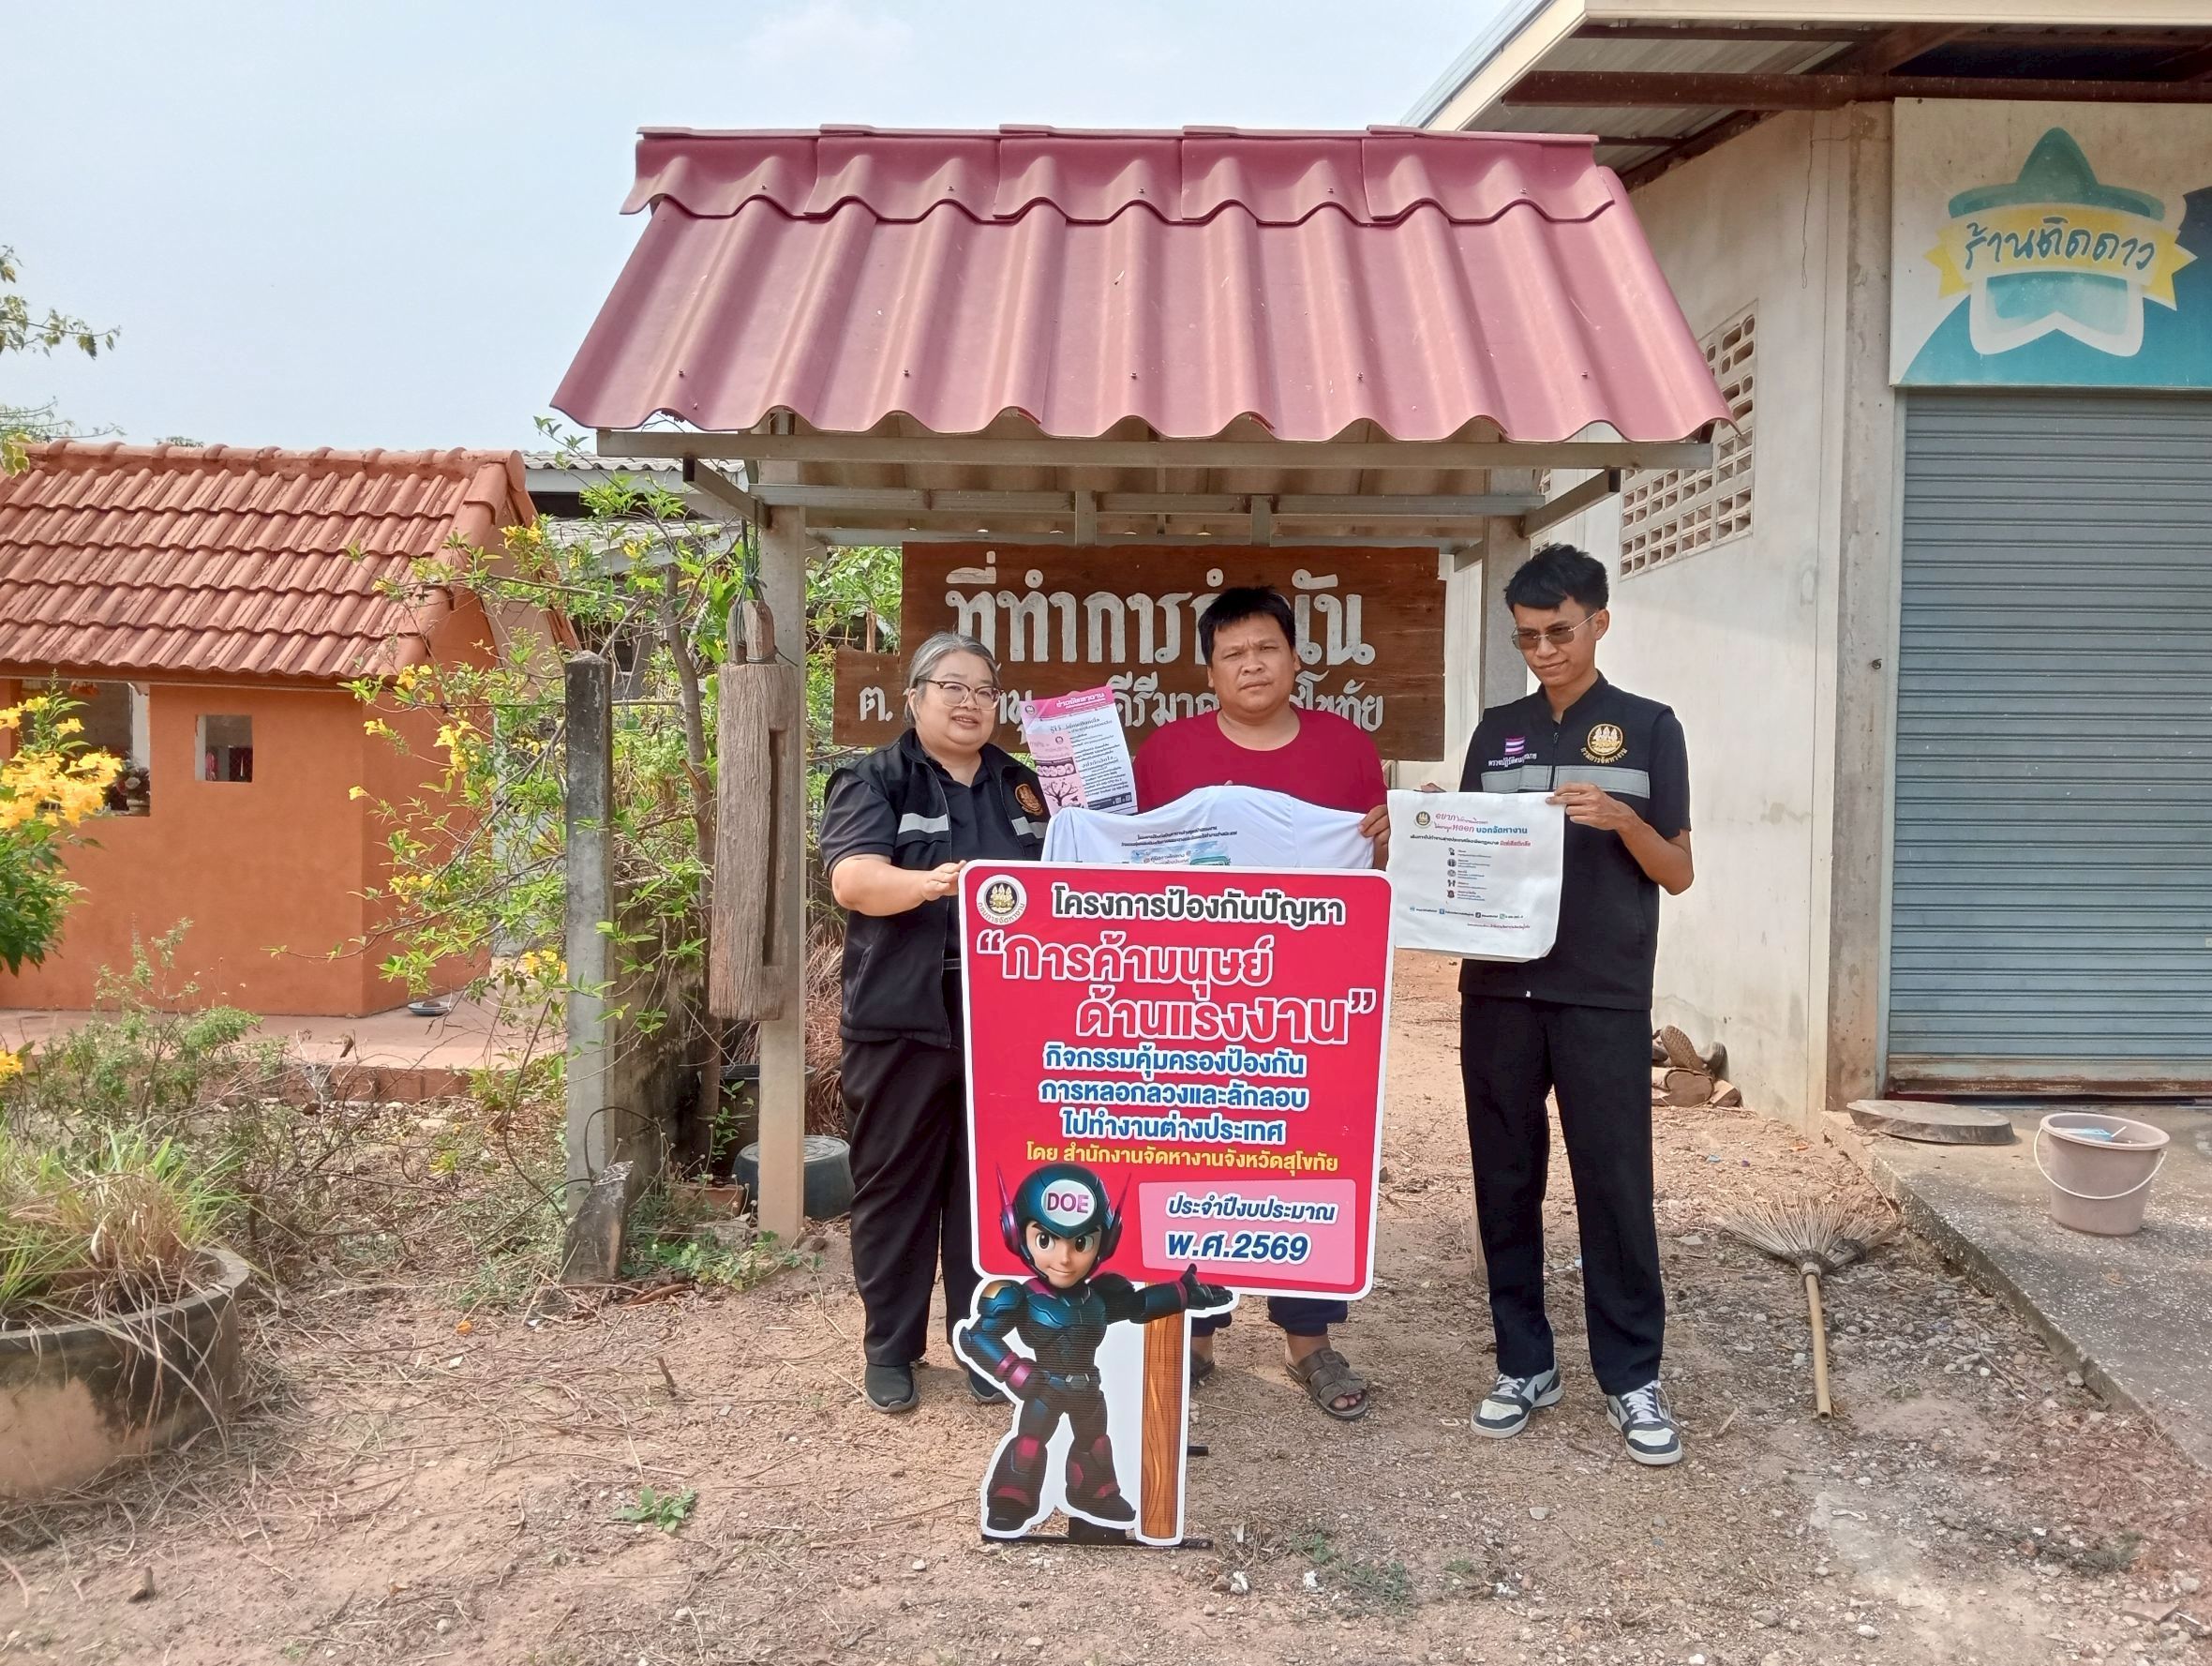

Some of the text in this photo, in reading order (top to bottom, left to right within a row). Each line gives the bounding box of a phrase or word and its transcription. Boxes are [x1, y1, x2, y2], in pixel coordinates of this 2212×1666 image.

[1053, 884, 1345, 926] โครงการป้องกันปัญหา
[1044, 1044, 1307, 1079] กิจกรรมคุ้มครองป้องกัน
[1039, 1081, 1308, 1109] การหลอกลวงและลักลอบ
[1061, 1110, 1285, 1144] ไปทำงานต่างประเทศ
[1026, 1141, 1339, 1177] โดย สำนักงานจัดหางานจังหวัดสุโขทัย
[1046, 1191, 1089, 1214] DOE
[1168, 1194, 1336, 1222] ประจำปีงบประมาณ
[1167, 1232, 1309, 1263] พ.ศ.2569
